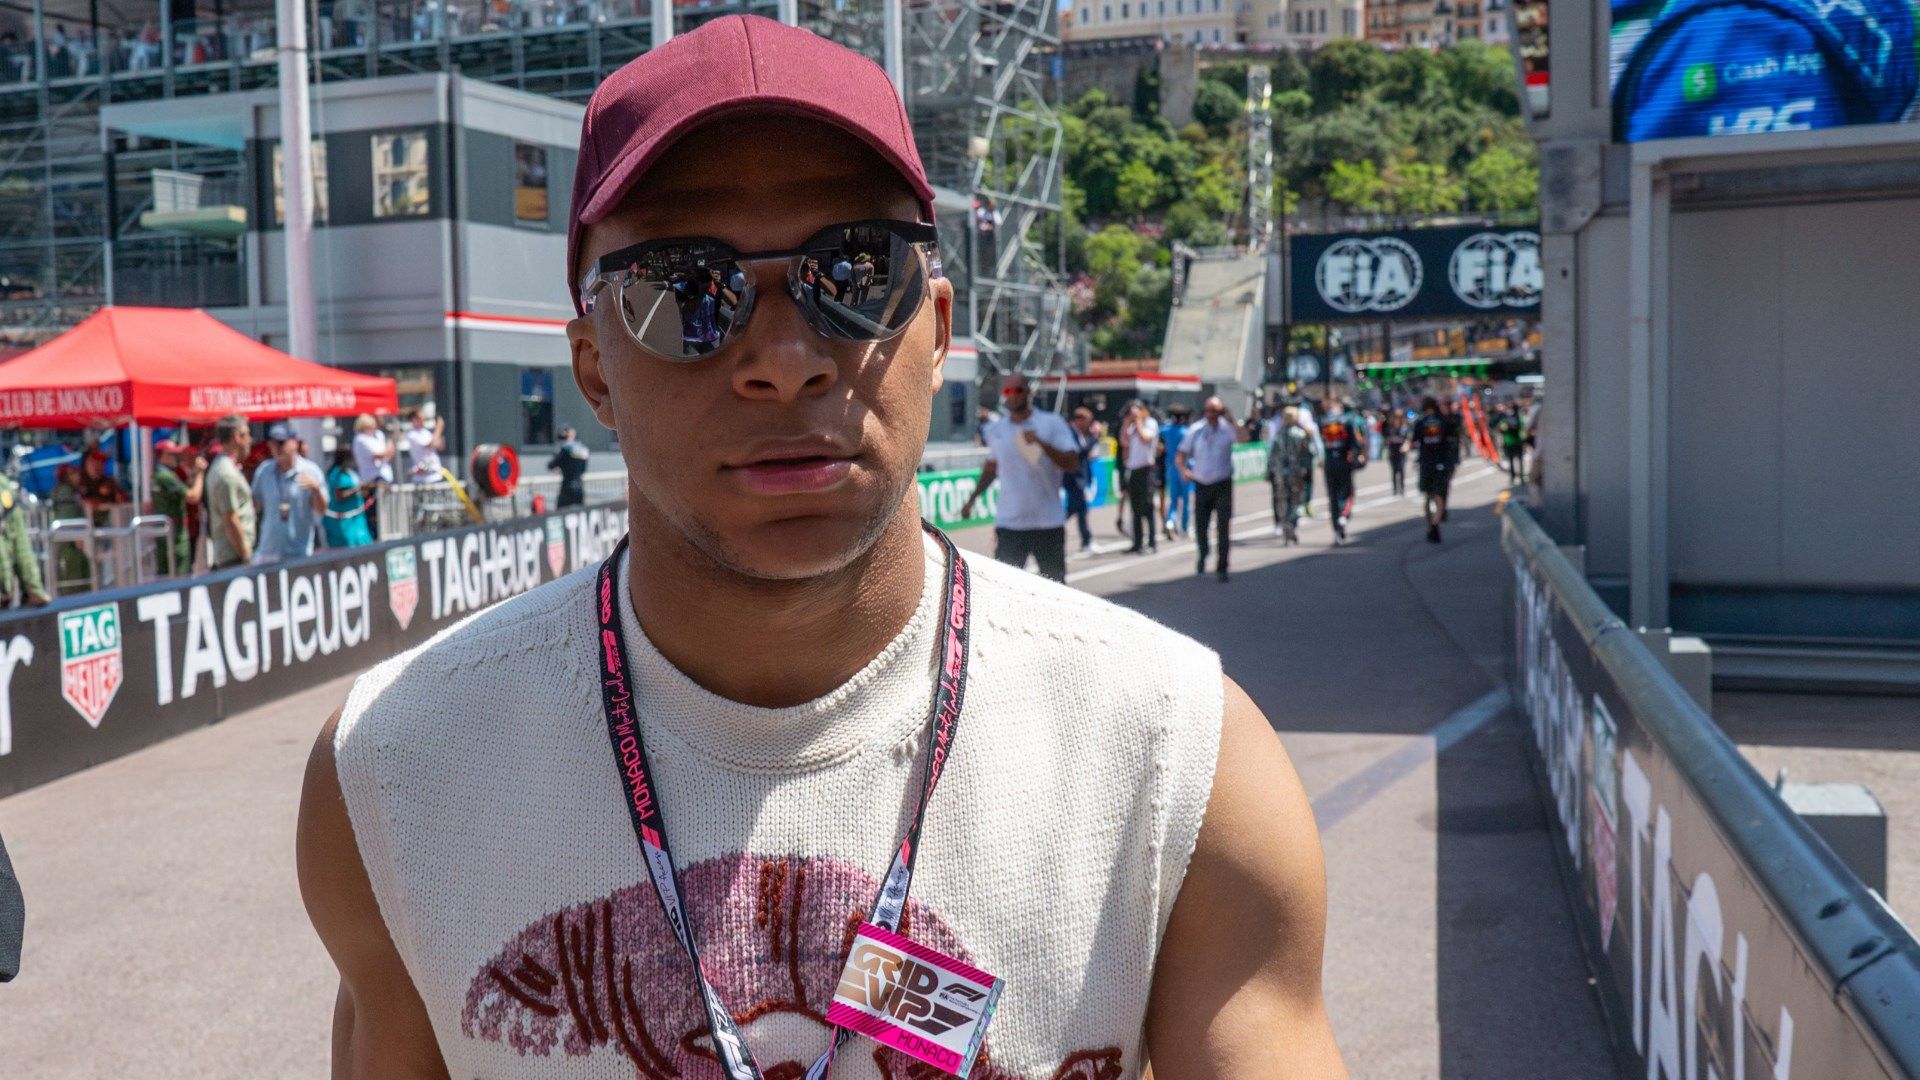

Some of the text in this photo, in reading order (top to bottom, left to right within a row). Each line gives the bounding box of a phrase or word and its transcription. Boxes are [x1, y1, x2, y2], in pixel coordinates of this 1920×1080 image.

[1723, 57, 1779, 84] Cash
[1783, 51, 1827, 75] App
[57, 386, 124, 414] MONACO
[950, 583, 966, 630] GRID
[64, 610, 116, 655] TAG
[65, 656, 121, 720] HEUER
[620, 736, 654, 820] MONACO
[853, 944, 939, 996] GRID
[896, 1029, 959, 1068] MONACO
